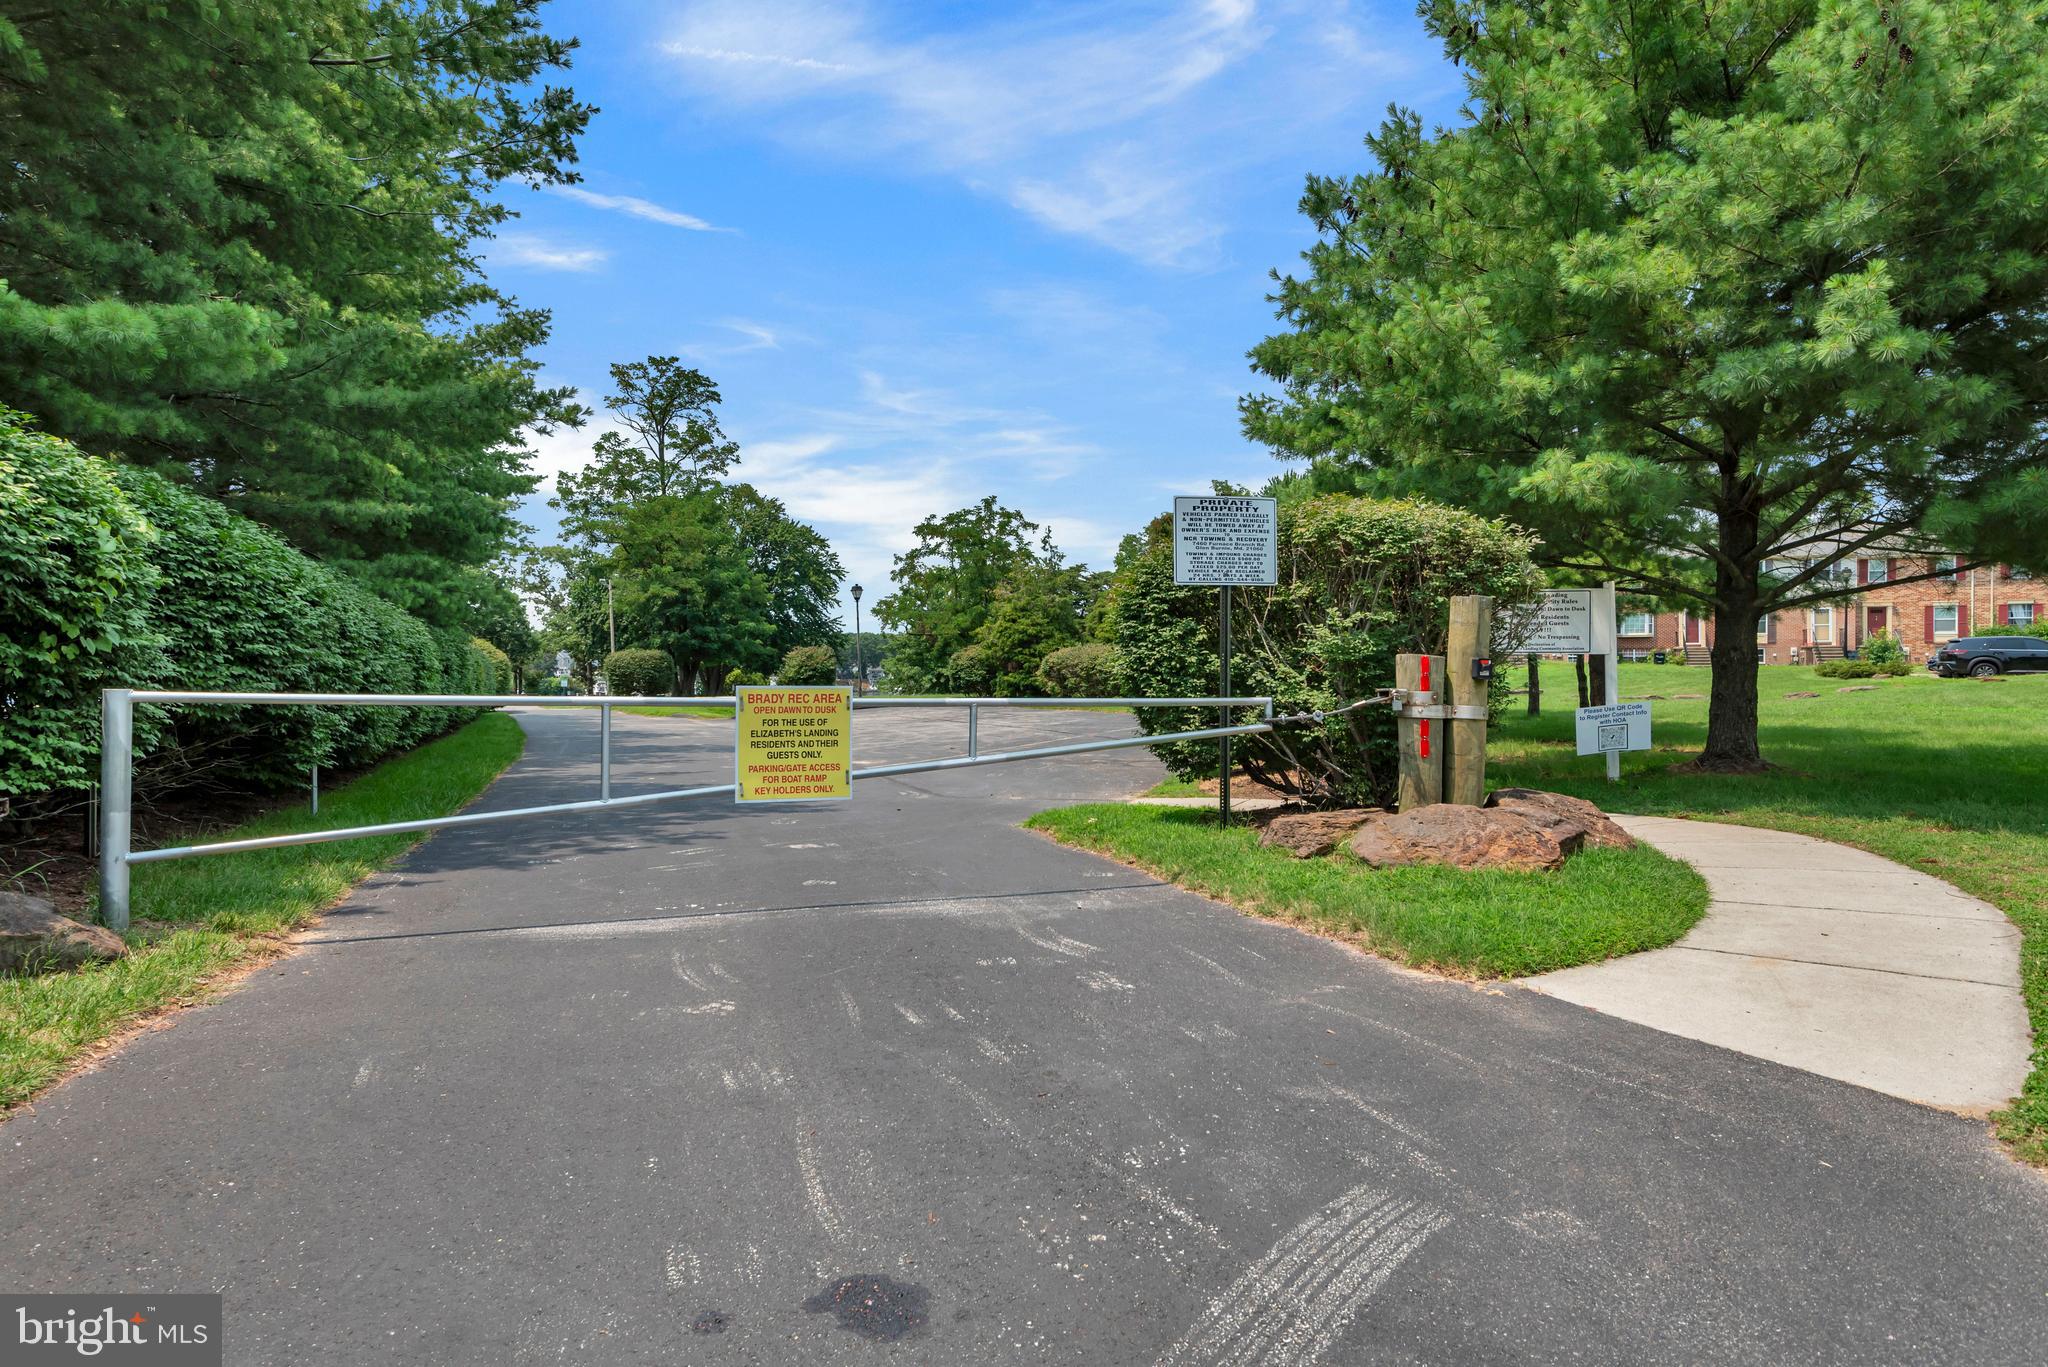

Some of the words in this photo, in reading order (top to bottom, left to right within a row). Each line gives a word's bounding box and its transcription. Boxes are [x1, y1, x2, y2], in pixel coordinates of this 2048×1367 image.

[748, 694, 784, 703] BRADY
[788, 694, 809, 703] REC
[813, 694, 842, 703] AREA
[751, 730, 801, 738] ELIZABETH'S
[804, 729, 839, 737] LANDING
[749, 764, 807, 773] PARKING/GATE
[773, 786, 811, 794] HOLDERS
